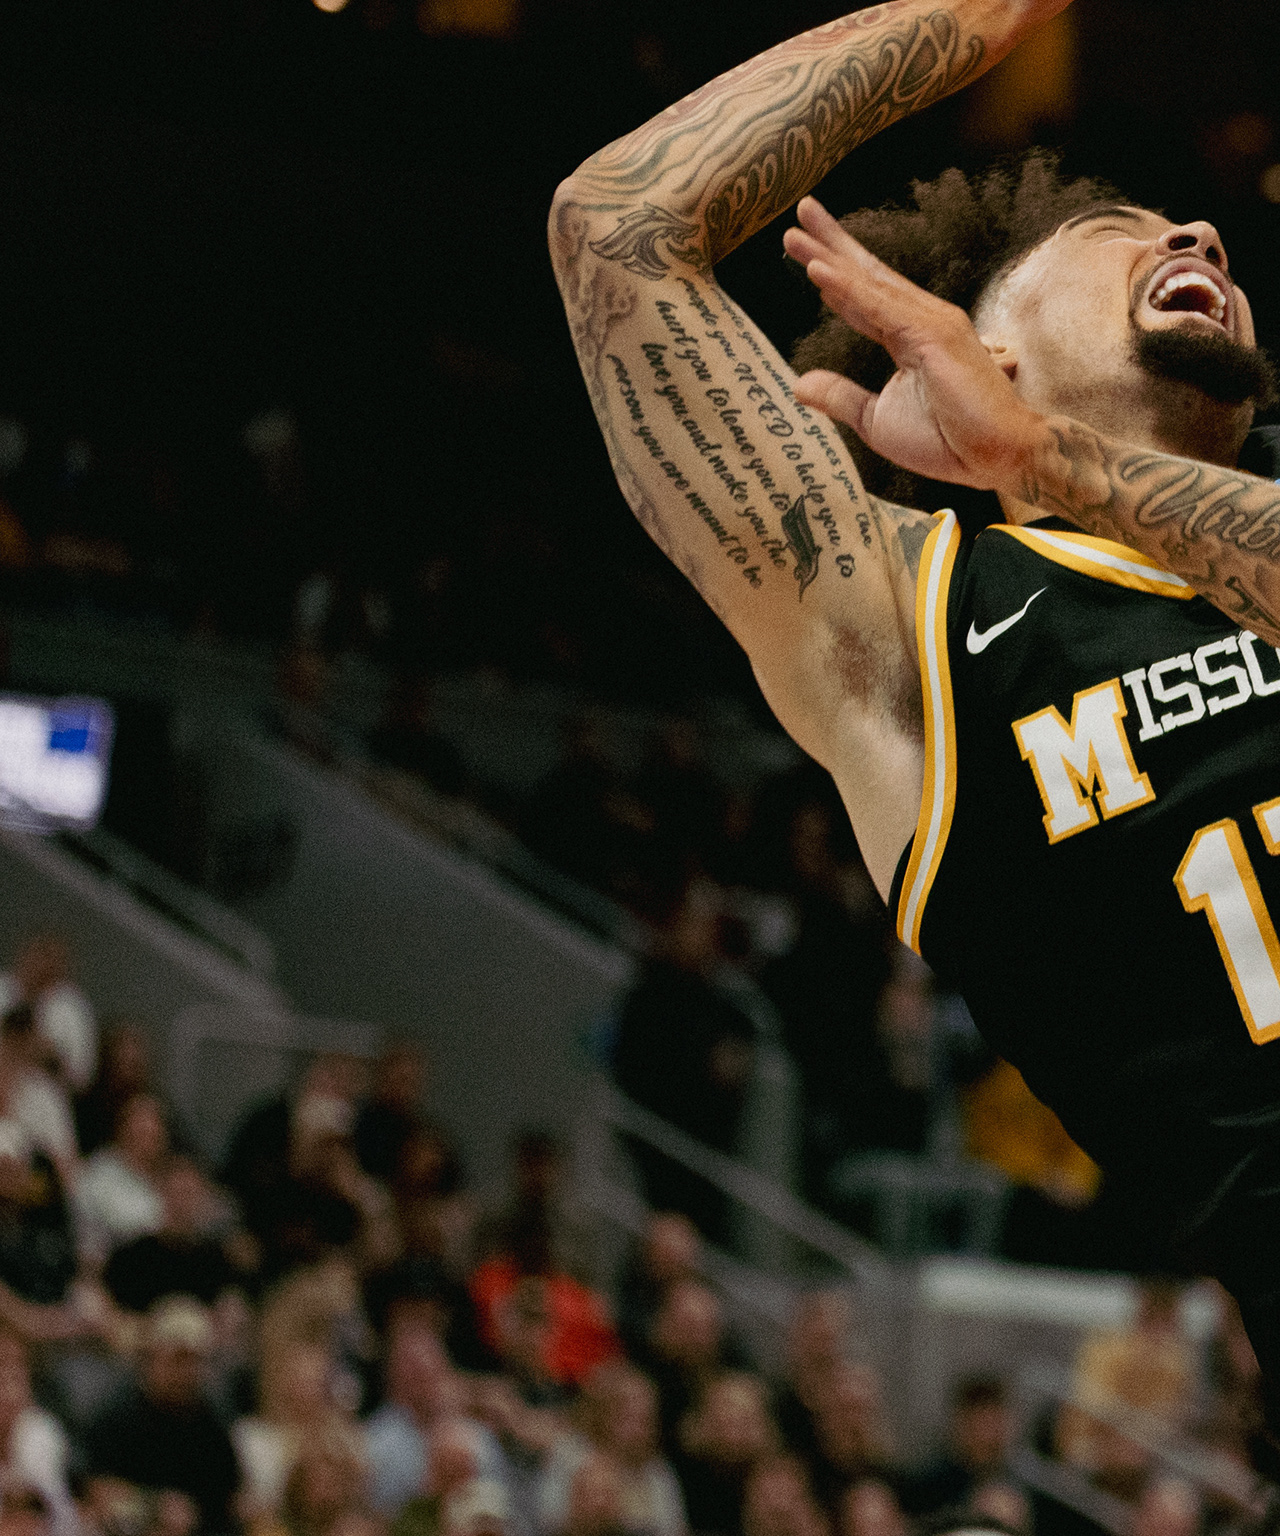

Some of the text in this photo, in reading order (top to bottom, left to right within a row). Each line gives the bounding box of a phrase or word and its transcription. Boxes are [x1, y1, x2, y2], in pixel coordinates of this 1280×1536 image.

[655, 300, 699, 355] hurt
[675, 346, 713, 386] you
[640, 341, 673, 384] love
[680, 417, 723, 458] and
[707, 453, 749, 504] make
[735, 505, 769, 539] you
[759, 537, 788, 570] the
[706, 322, 736, 360] you
[733, 361, 794, 438] NEED
[781, 441, 803, 462] to
[796, 462, 827, 506] help
[834, 551, 857, 580] to
[718, 408, 758, 457] leave
[605, 352, 765, 591] person you are meant to be
[742, 457, 777, 492] you
[833, 467, 860, 504] you
[767, 490, 790, 512] to
